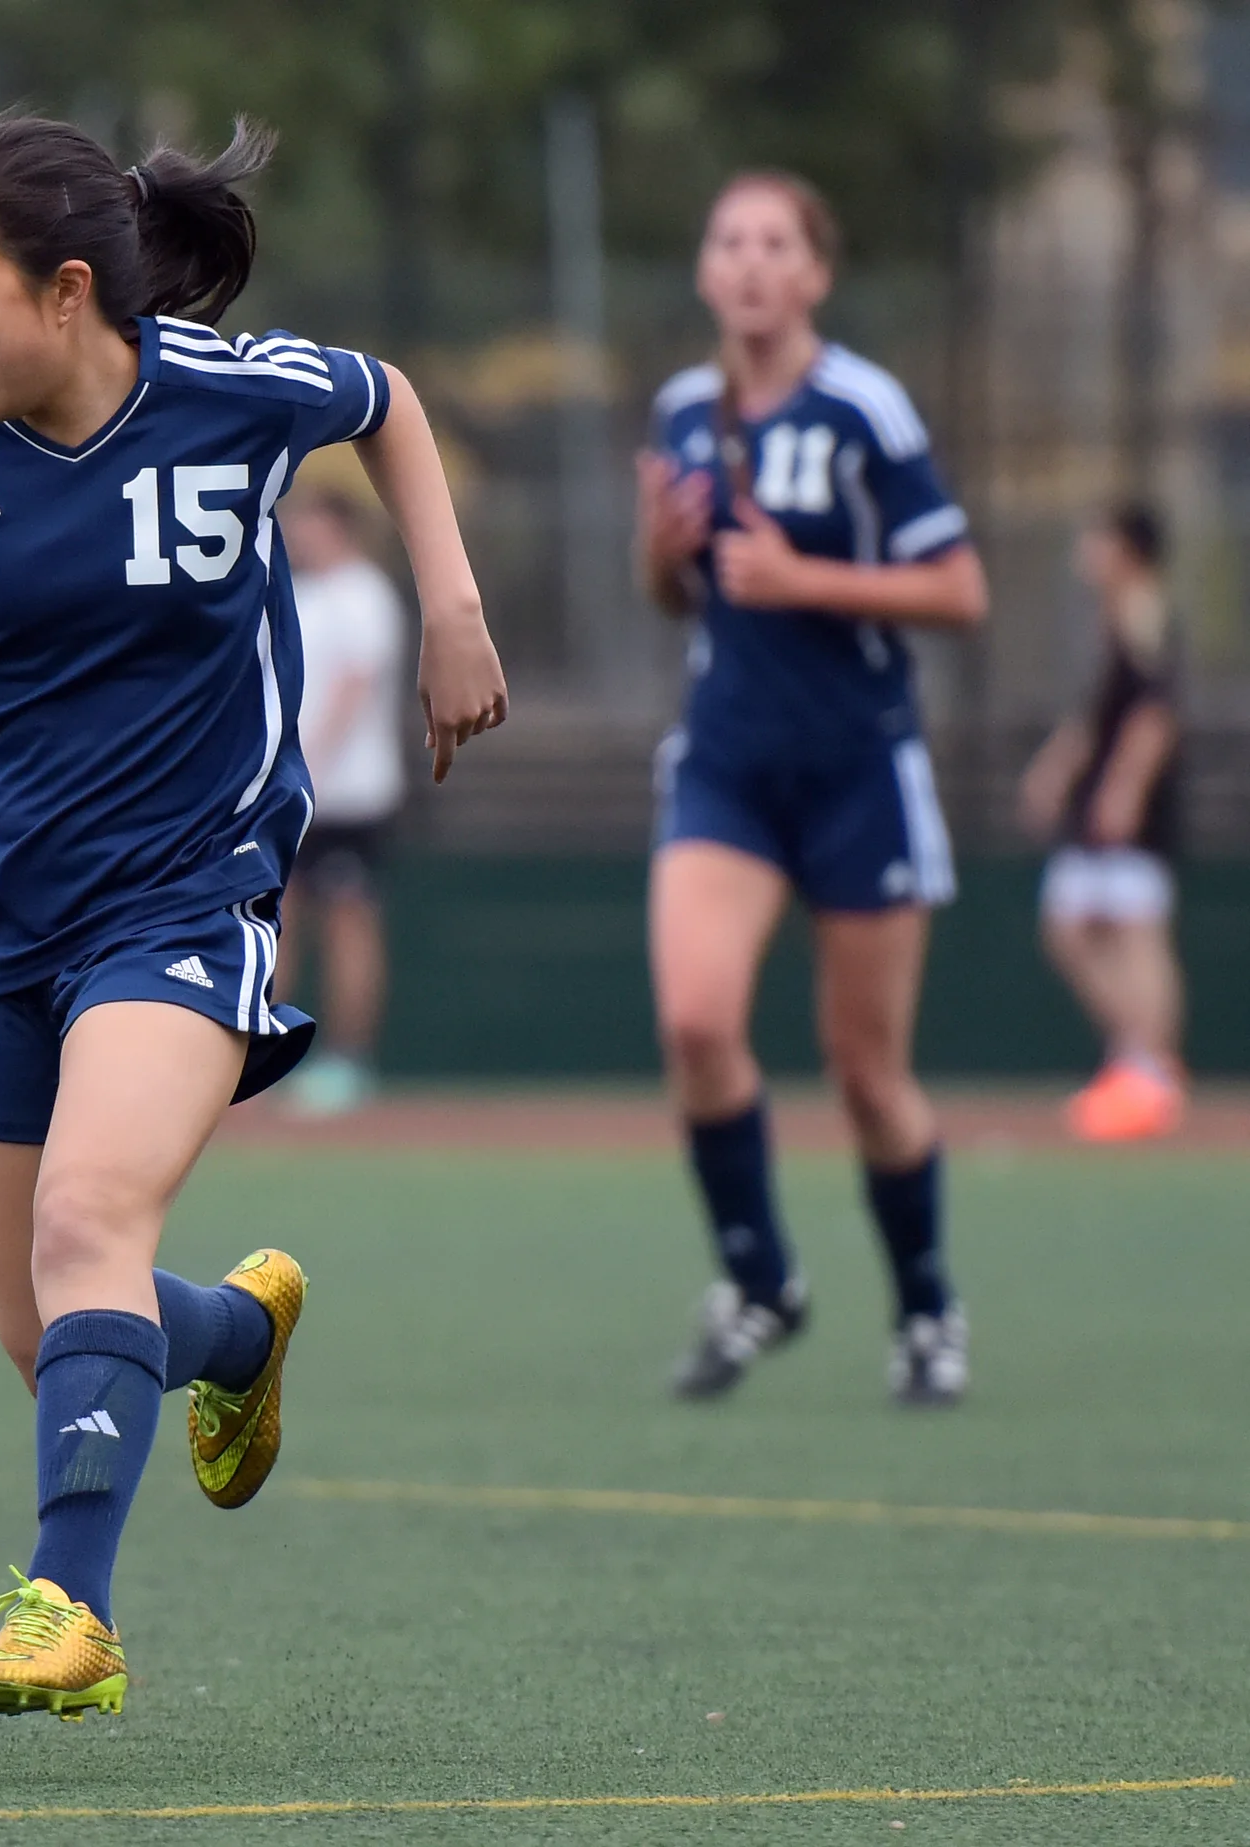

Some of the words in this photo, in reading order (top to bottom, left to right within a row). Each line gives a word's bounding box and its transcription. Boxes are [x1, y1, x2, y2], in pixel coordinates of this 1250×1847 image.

[756, 422, 836, 514] 11
[122, 464, 249, 586] 15
[165, 967, 214, 988] adidas
